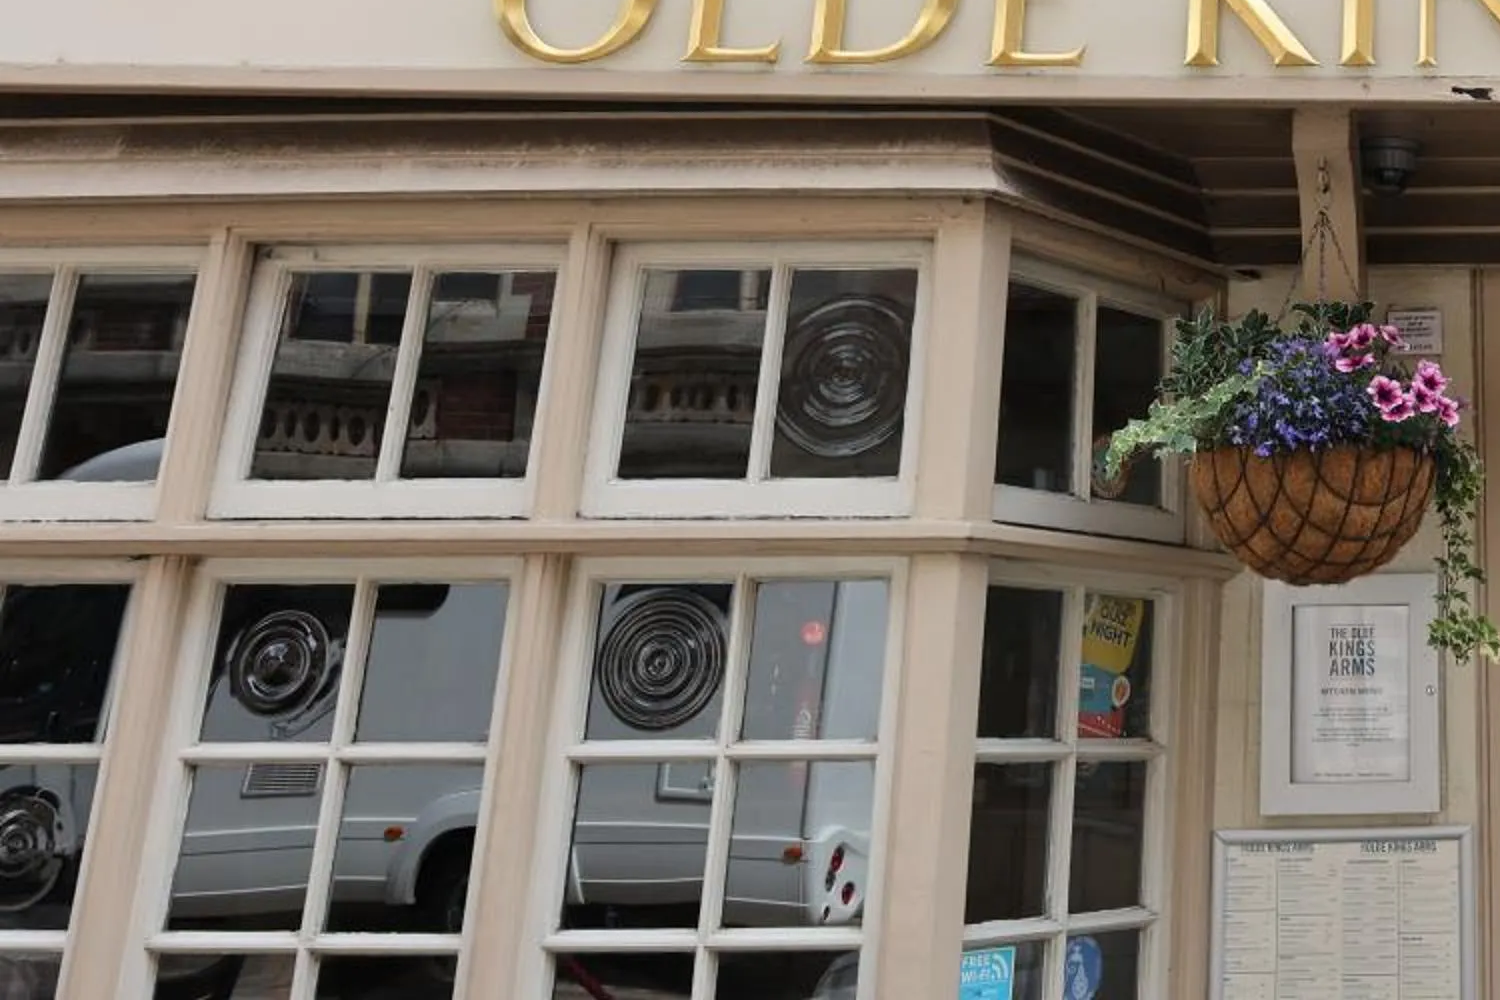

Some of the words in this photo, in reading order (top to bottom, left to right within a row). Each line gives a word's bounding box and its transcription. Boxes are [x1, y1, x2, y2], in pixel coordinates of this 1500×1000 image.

[1330, 627, 1347, 639] THE
[1329, 640, 1376, 657] KINGS
[1329, 658, 1376, 677] ARMS
[962, 953, 991, 969] FREE
